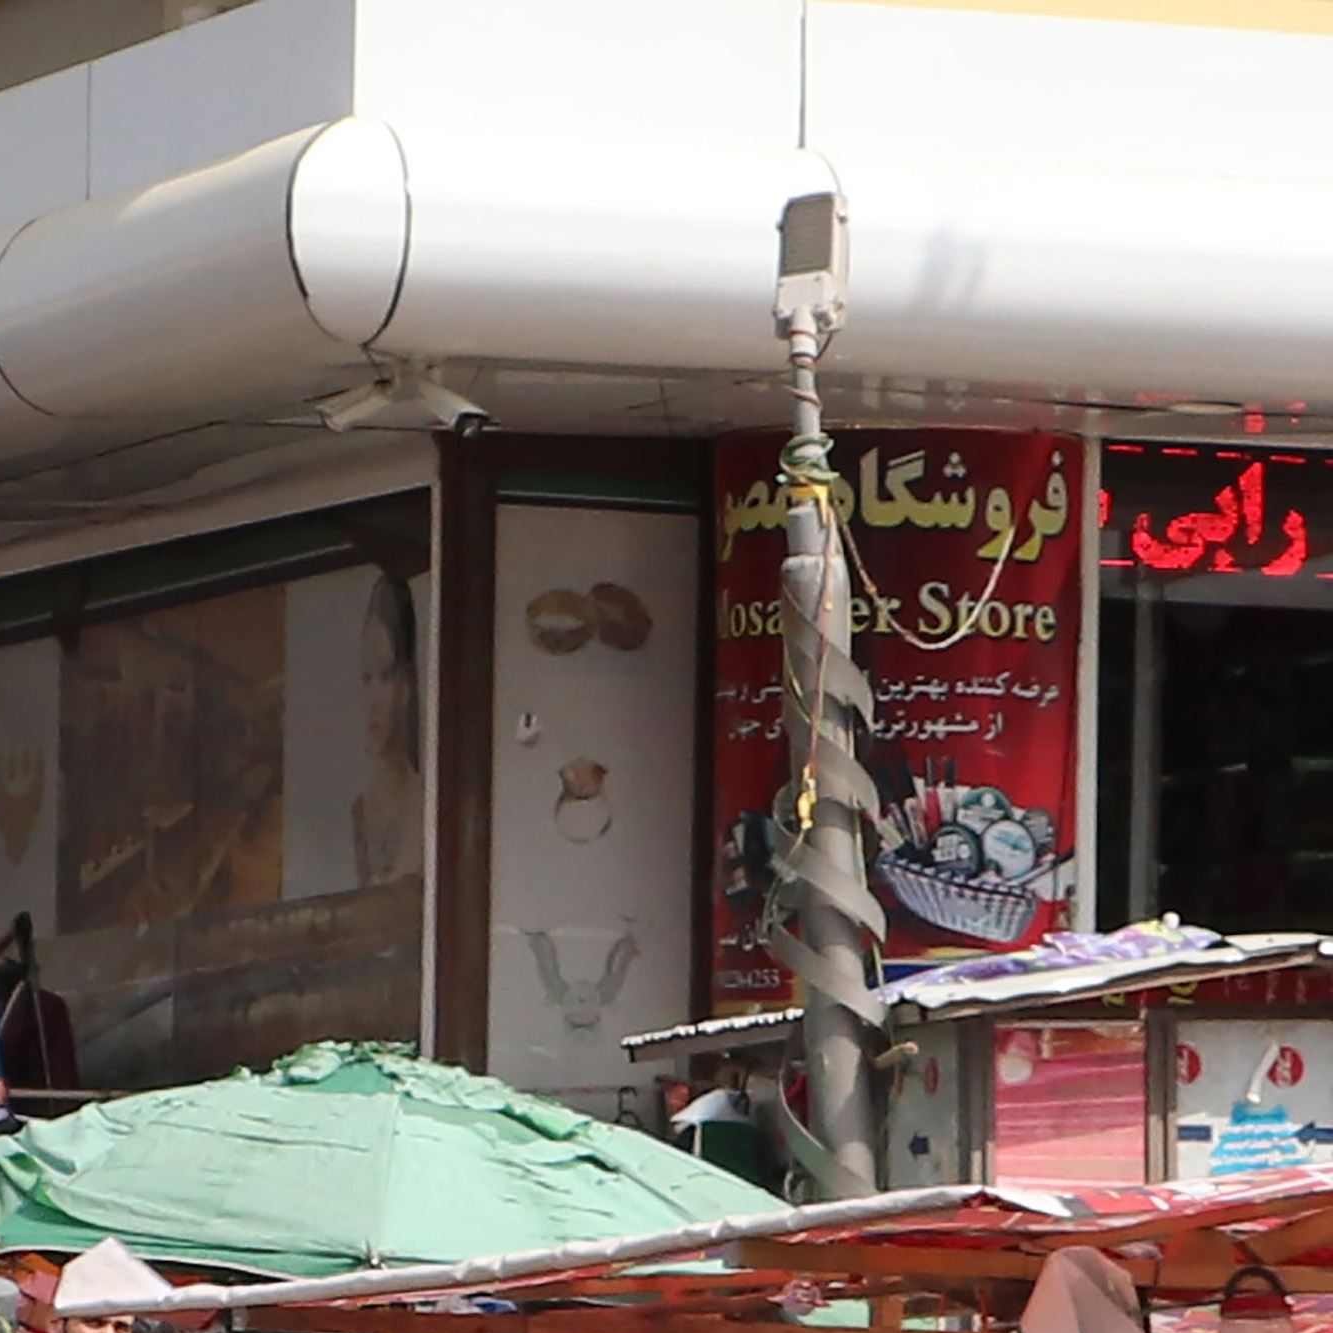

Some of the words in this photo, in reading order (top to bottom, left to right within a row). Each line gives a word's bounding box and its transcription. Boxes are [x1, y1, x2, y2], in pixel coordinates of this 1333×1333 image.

[918, 580, 1058, 642] Store
[875, 673, 949, 702] بهترین
[955, 671, 1011, 696] کننده
[1010, 675, 1060, 707] عرضه
[871, 709, 979, 741] مشهورتری
